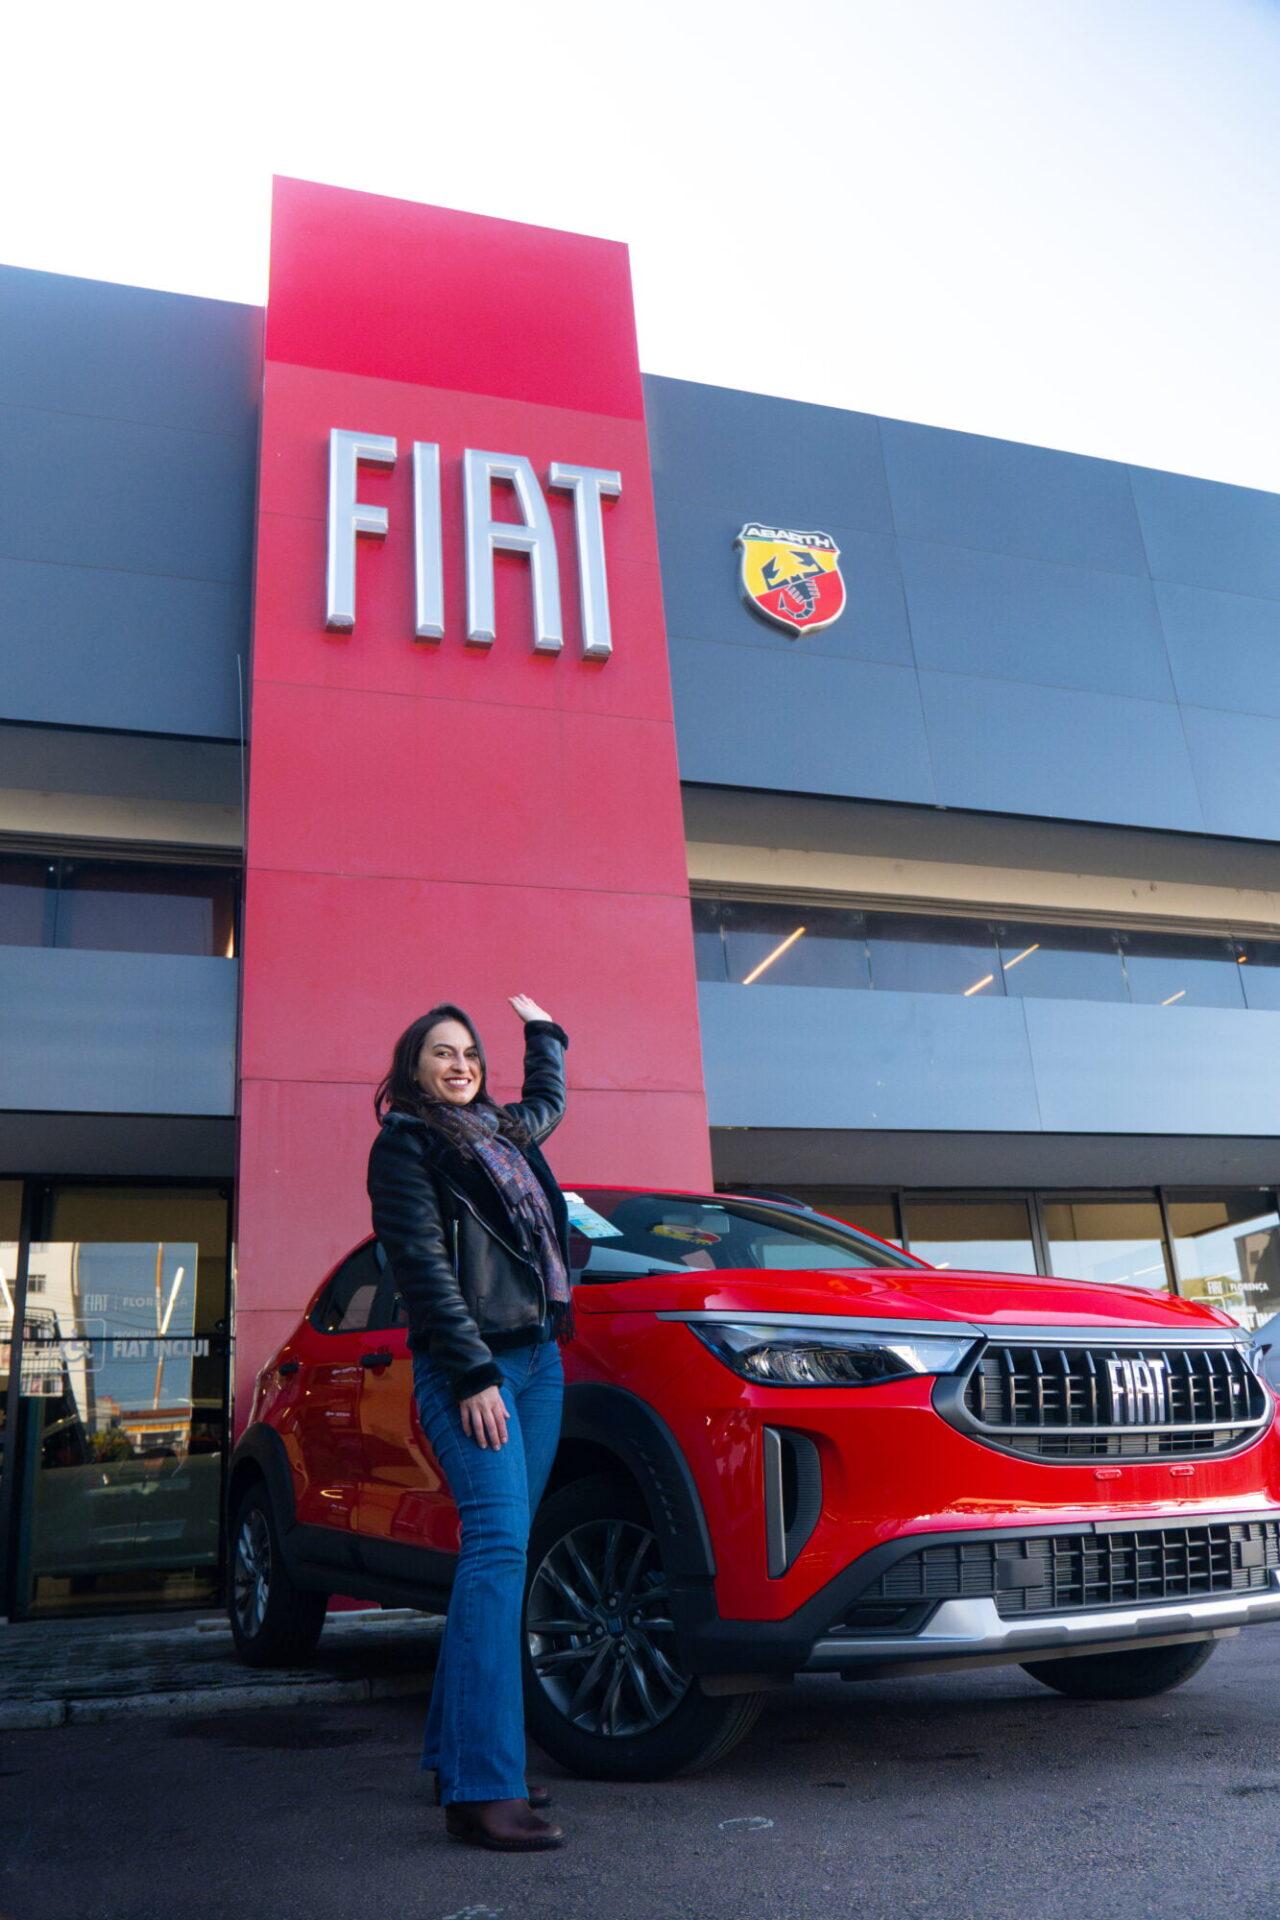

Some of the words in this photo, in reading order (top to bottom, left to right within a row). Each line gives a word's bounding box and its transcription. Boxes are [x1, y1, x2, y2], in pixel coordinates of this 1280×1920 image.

[326, 428, 622, 662] FIAT
[746, 527, 830, 549] ABARTH
[84, 1294, 109, 1312] FIAT
[113, 1340, 149, 1358] FIAT
[154, 1340, 209, 1358] INCLUI
[1107, 1359, 1166, 1424] FIAT
